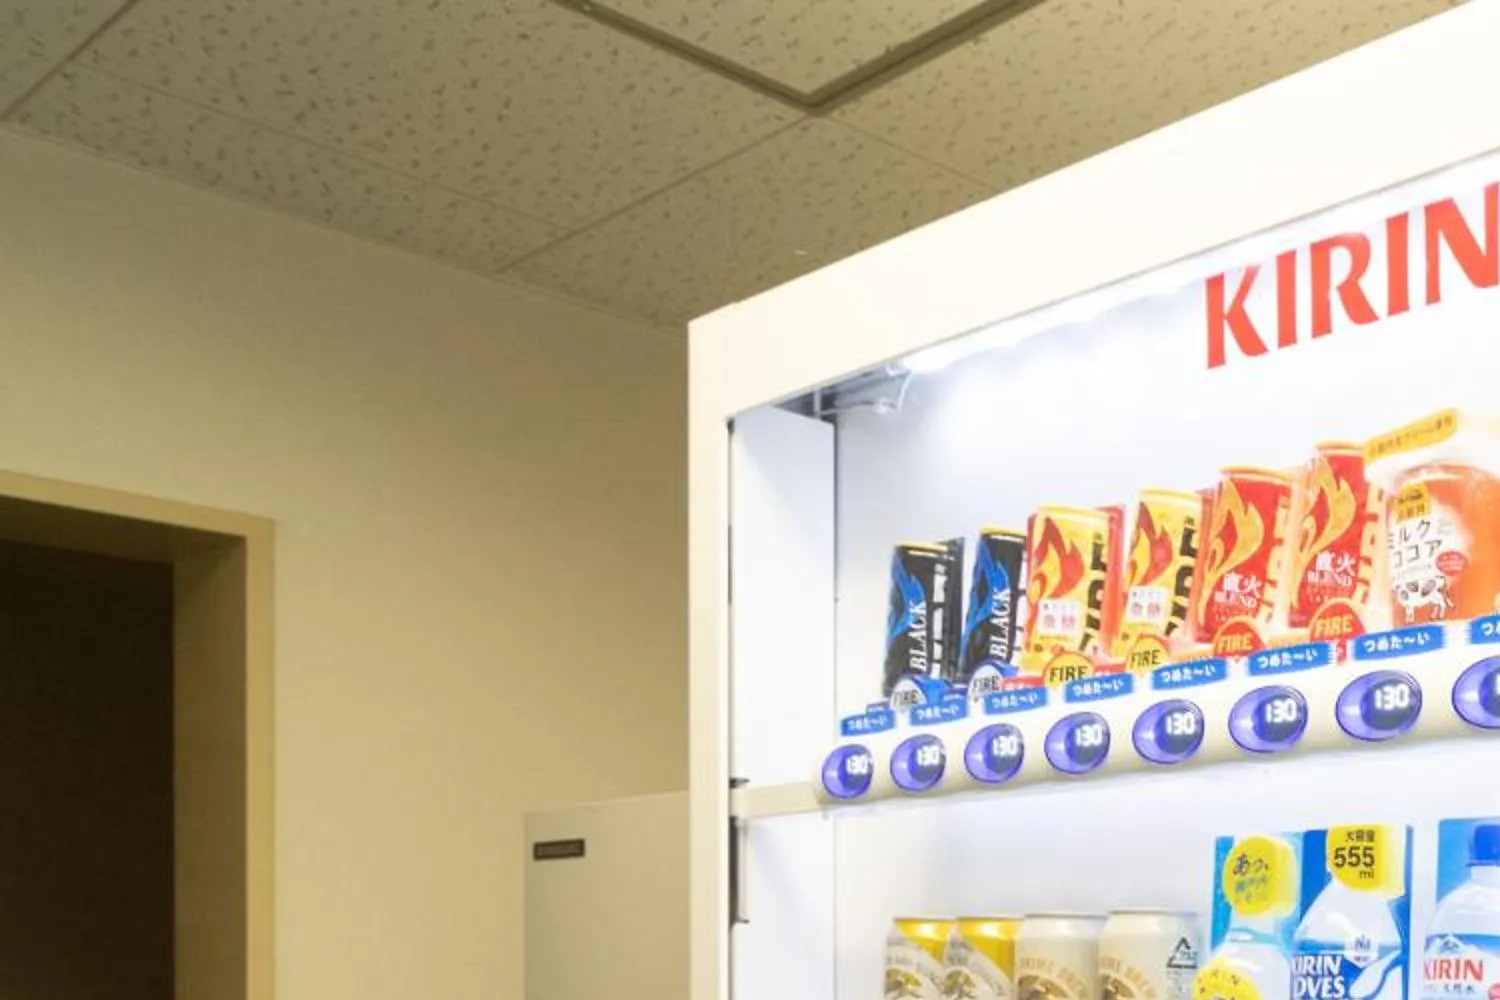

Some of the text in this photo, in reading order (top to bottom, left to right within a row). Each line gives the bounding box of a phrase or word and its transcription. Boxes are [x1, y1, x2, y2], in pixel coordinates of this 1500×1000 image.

[1205, 180, 1500, 370] KIRIN
[990, 587, 1011, 660] BLACK
[1315, 613, 1353, 636] FIRE
[908, 600, 928, 672] BLACK
[1219, 633, 1252, 650] FIRE
[1130, 648, 1161, 669] FIRE
[972, 675, 1001, 695] FIRE
[1050, 665, 1087, 683] FIRE
[1373, 685, 1410, 710] 130
[1265, 699, 1297, 723] 130
[1075, 724, 1102, 747] 130
[1165, 713, 1196, 736] 130
[1333, 845, 1376, 868] 555
[1424, 958, 1484, 982] KIRIN
